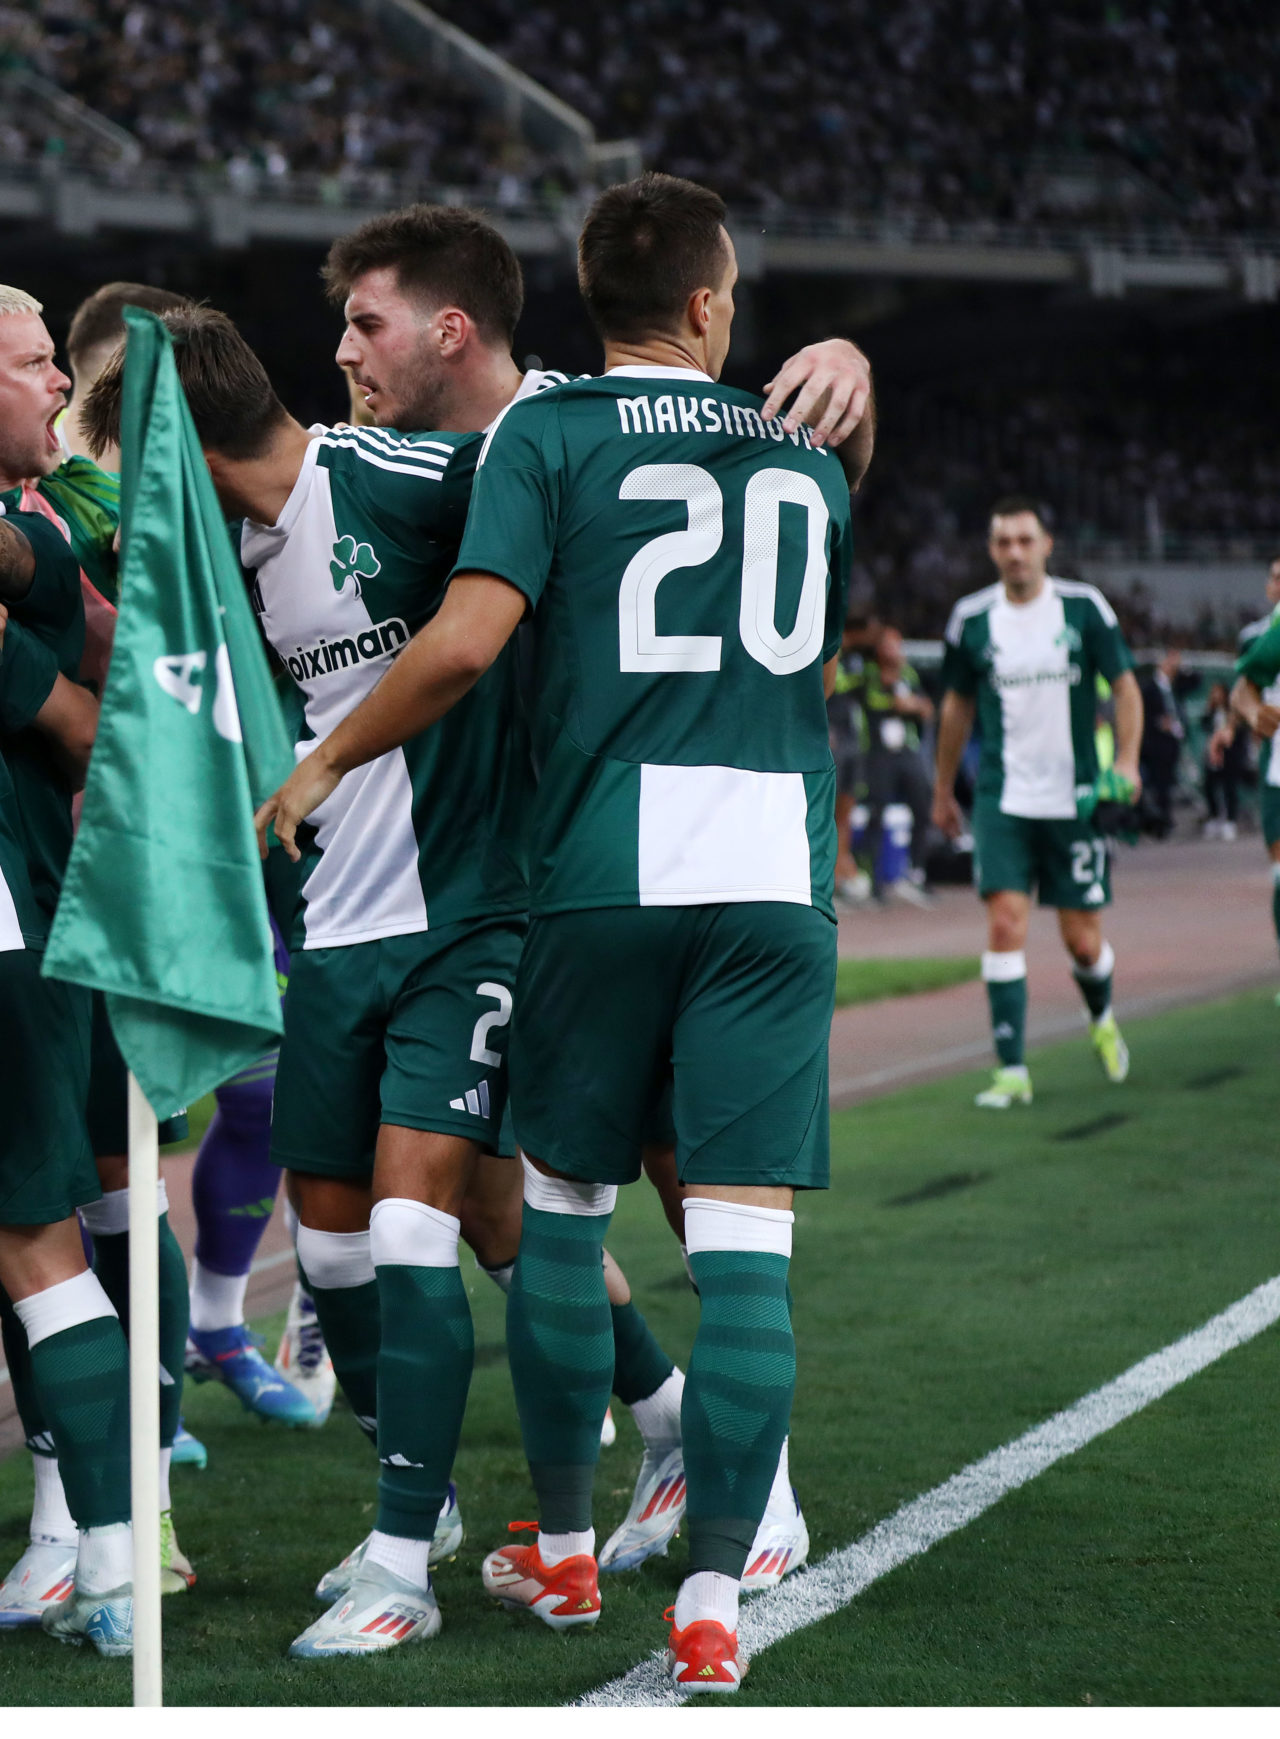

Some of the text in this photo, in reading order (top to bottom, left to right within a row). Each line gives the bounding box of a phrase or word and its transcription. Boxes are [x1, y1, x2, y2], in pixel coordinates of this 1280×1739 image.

[619, 464, 829, 676] 20
[470, 982, 512, 1068] 2
[388, 1602, 427, 1621] F50
